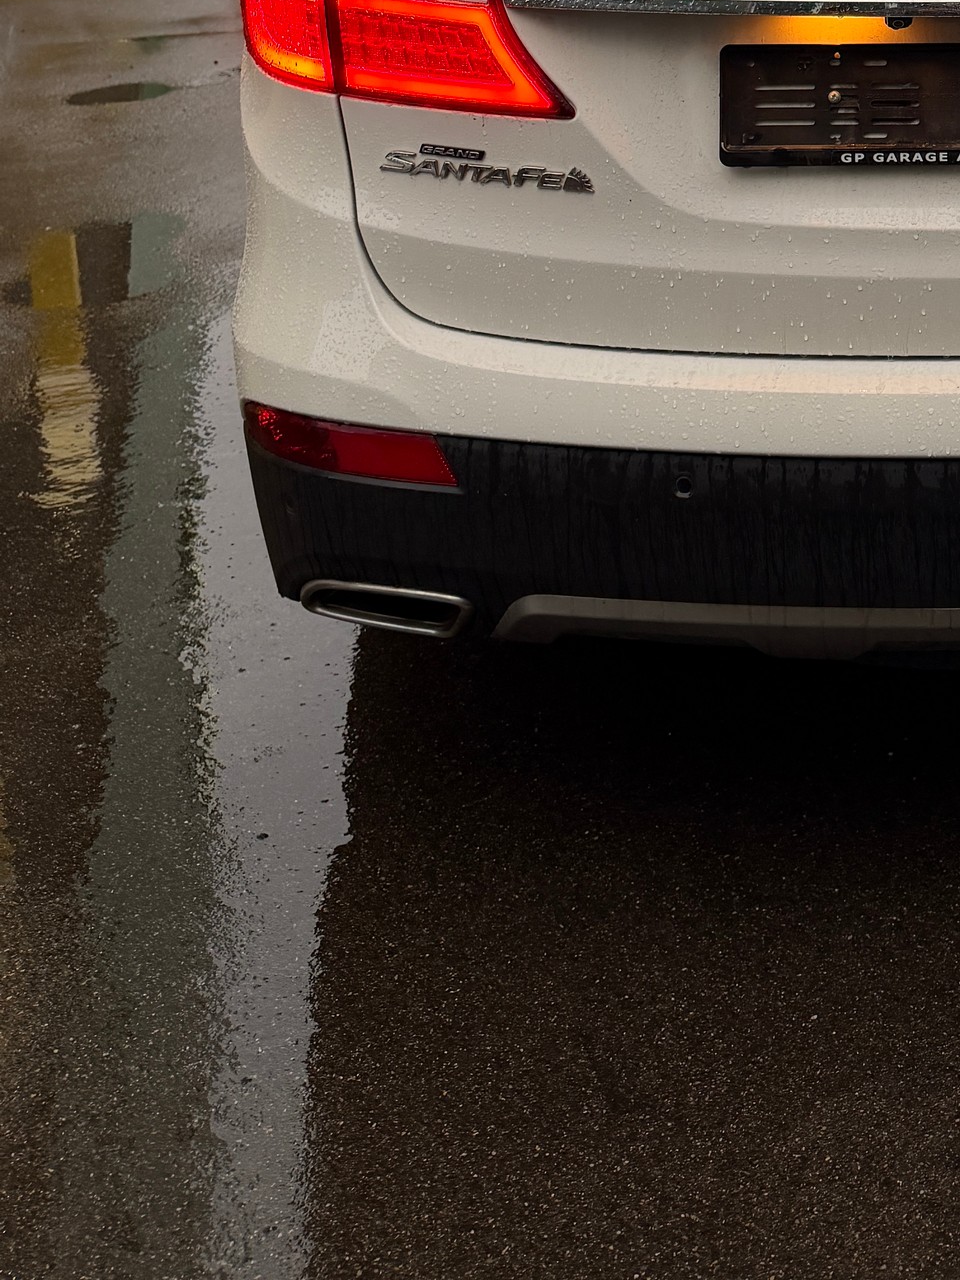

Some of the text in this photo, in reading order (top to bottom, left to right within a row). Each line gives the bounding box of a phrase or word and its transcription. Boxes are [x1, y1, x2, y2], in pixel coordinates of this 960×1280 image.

[420, 145, 480, 160] GRAND
[840, 152, 865, 163] GP
[873, 152, 949, 163] GARAGE
